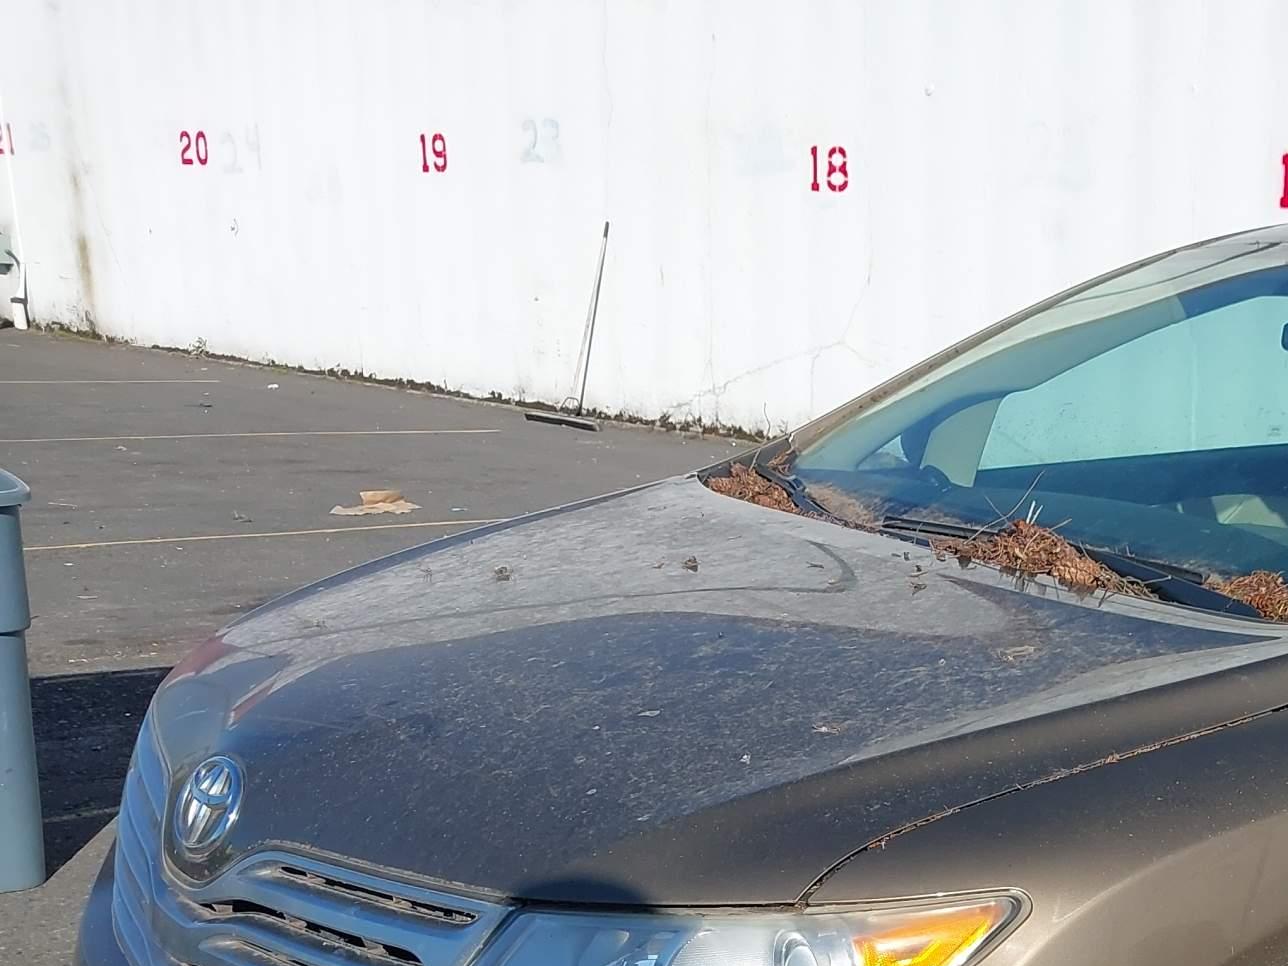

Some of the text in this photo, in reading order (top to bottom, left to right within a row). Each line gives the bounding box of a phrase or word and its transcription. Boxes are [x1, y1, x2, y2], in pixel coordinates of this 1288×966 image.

[179, 130, 208, 165] 20
[419, 133, 447, 173] 19
[810, 146, 849, 193] 18
